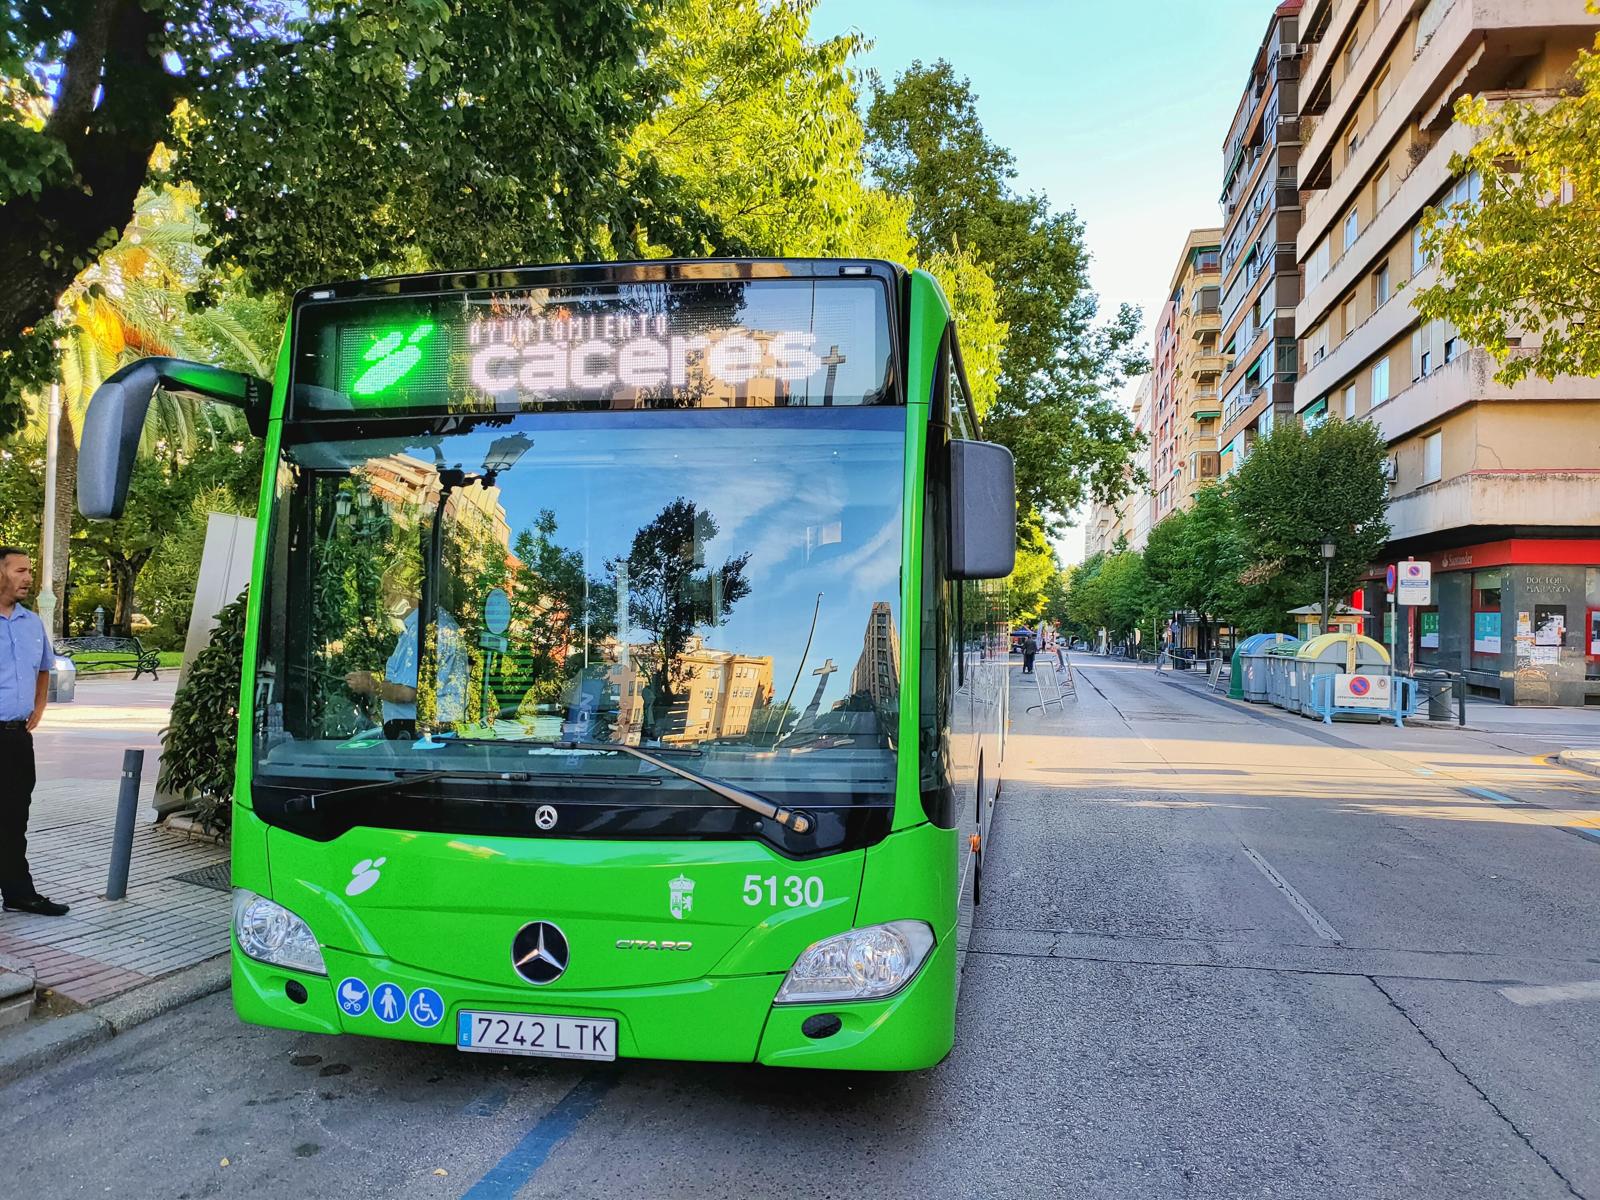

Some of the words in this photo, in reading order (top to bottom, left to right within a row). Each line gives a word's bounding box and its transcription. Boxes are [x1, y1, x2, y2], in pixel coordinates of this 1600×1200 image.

[469, 313, 667, 345] AYUNTAMIENTO
[742, 874, 824, 908] 5130
[615, 939, 693, 951] CITARO
[477, 1017, 545, 1048] 7242
[556, 1023, 608, 1053] LTK
